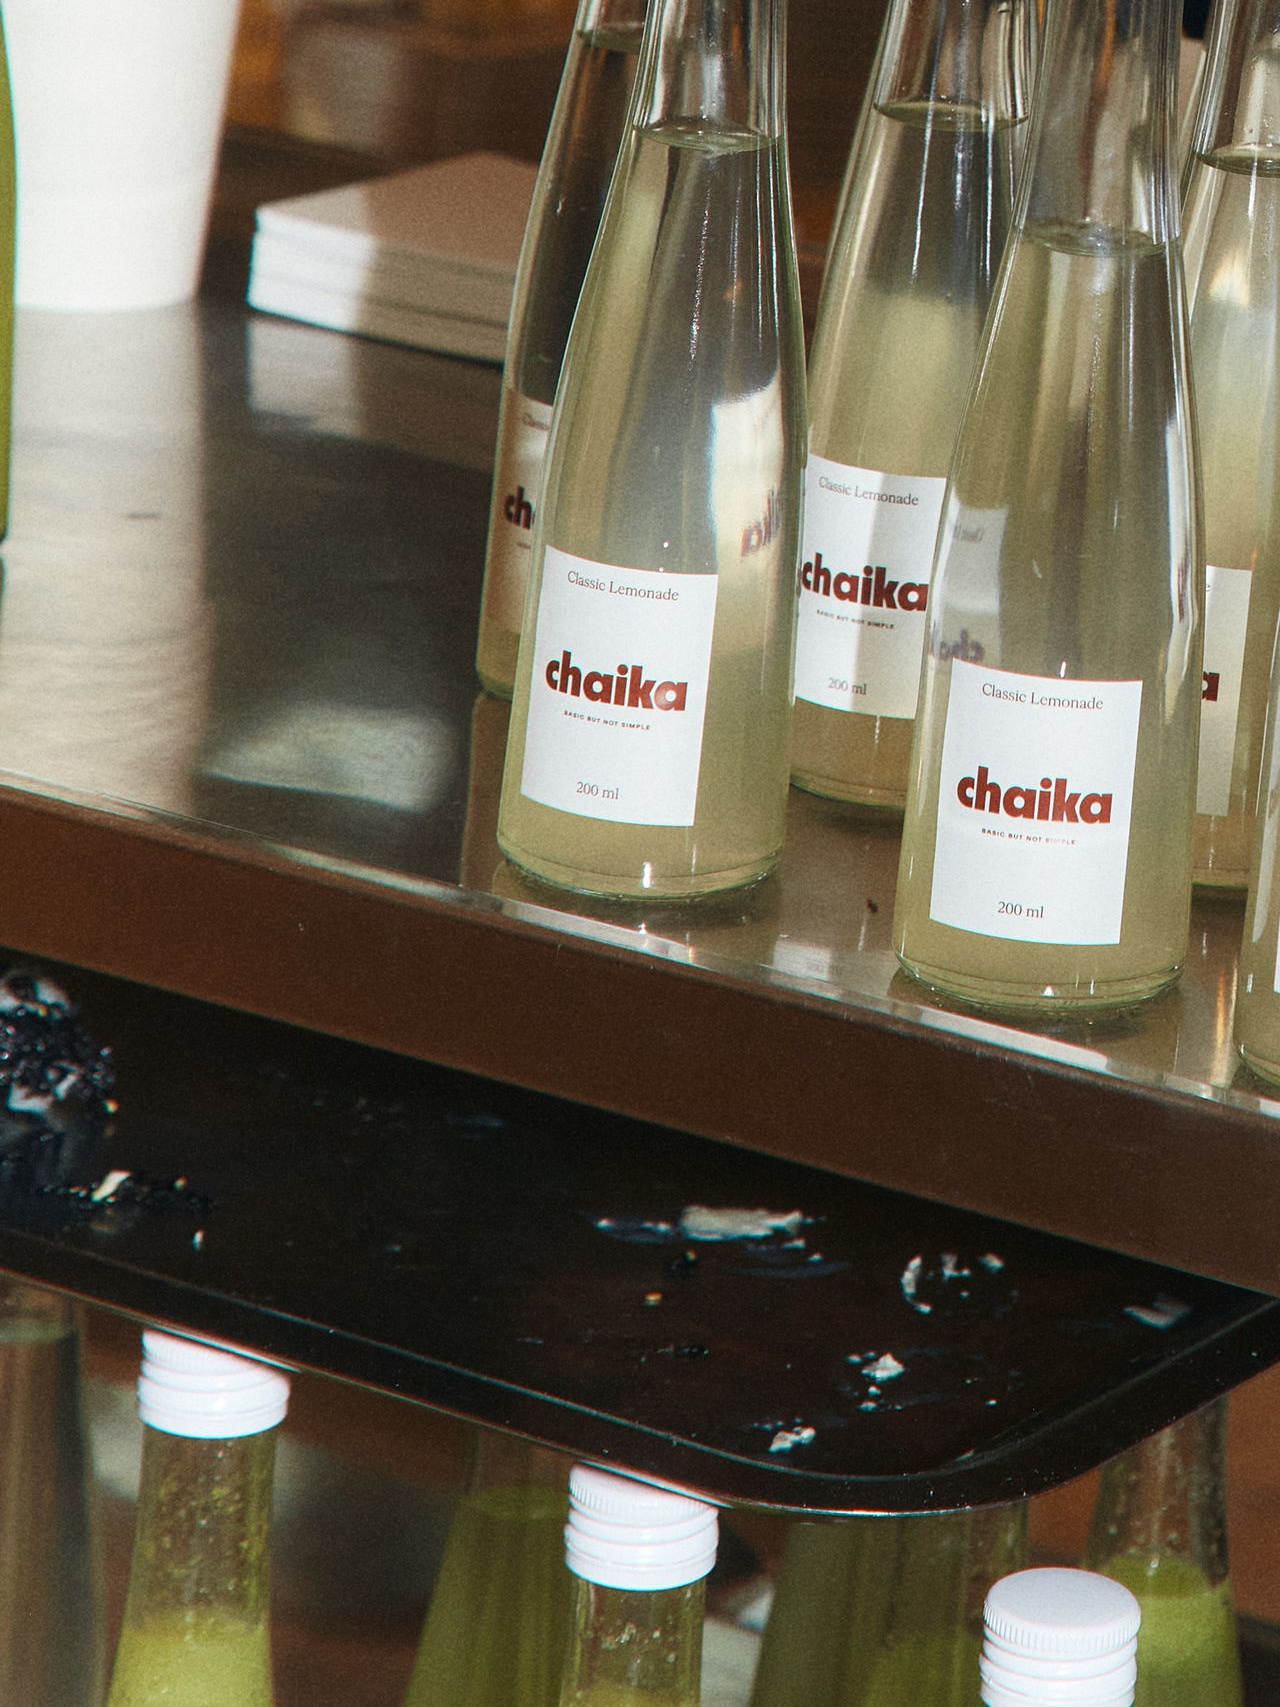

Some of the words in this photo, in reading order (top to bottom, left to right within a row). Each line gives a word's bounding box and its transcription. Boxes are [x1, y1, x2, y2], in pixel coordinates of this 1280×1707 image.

[820, 476, 852, 496] Classic
[854, 486, 919, 506] Lemonade
[567, 570, 606, 592] Classic
[609, 581, 680, 601] Lemonade
[802, 552, 929, 611] chaika
[545, 650, 688, 711] chaika
[828, 677, 849, 692] 200
[851, 683, 867, 696] ml
[982, 683, 1027, 704] Classic
[1030, 692, 1103, 710] Lemonade
[564, 710, 585, 720] BASIC
[587, 716, 600, 724] BUT
[603, 719, 618, 727] NOT
[621, 722, 650, 731] SIMPLE
[576, 781, 599, 796] 200
[601, 787, 619, 800] ml
[957, 765, 1113, 824] chaika
[981, 827, 1005, 838] BASIC
[1008, 833, 1023, 841] BUT
[997, 901, 1022, 916] 200
[1026, 906, 1044, 918] ml
